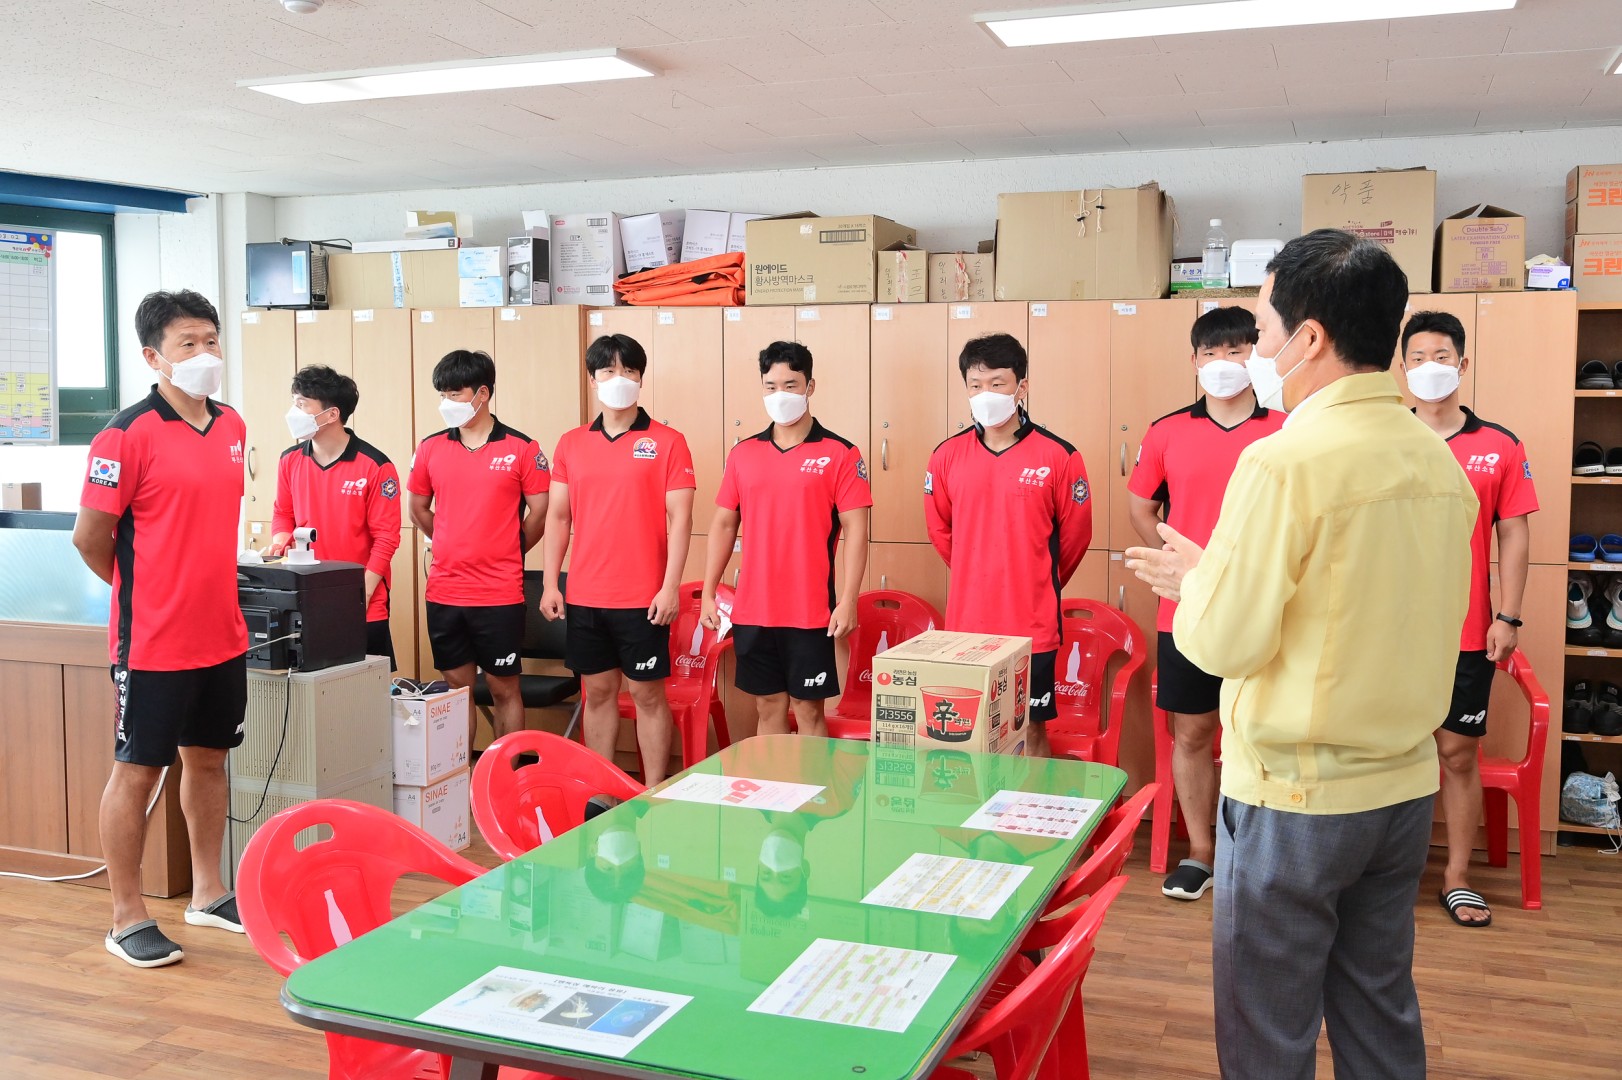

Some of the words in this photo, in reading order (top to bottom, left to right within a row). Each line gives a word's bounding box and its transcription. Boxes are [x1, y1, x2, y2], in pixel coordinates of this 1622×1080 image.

[755, 264, 788, 275] 원에이드
[755, 274, 815, 287] 황사방역마스크
[490, 454, 517, 466] 119
[802, 456, 831, 469] 119
[1467, 452, 1500, 468] 119
[799, 466, 824, 476] 부산소방
[1019, 466, 1051, 480] 119
[1466, 464, 1495, 475] 부산소방
[91, 477, 113, 487] KOREA
[342, 477, 368, 489] 119
[1018, 477, 1045, 488] 부산소방
[495, 652, 517, 667] 119
[635, 656, 658, 671] 119
[803, 671, 827, 687] 119
[892, 675, 917, 686] 농심
[430, 701, 452, 719] SINAE
[879, 709, 914, 721] 가3556
[932, 698, 959, 735] 辛
[1458, 709, 1486, 725] 119
[458, 753, 467, 764] A4
[407, 793, 416, 801] A4
[425, 784, 448, 803] SINAE
[457, 831, 467, 844] A4
